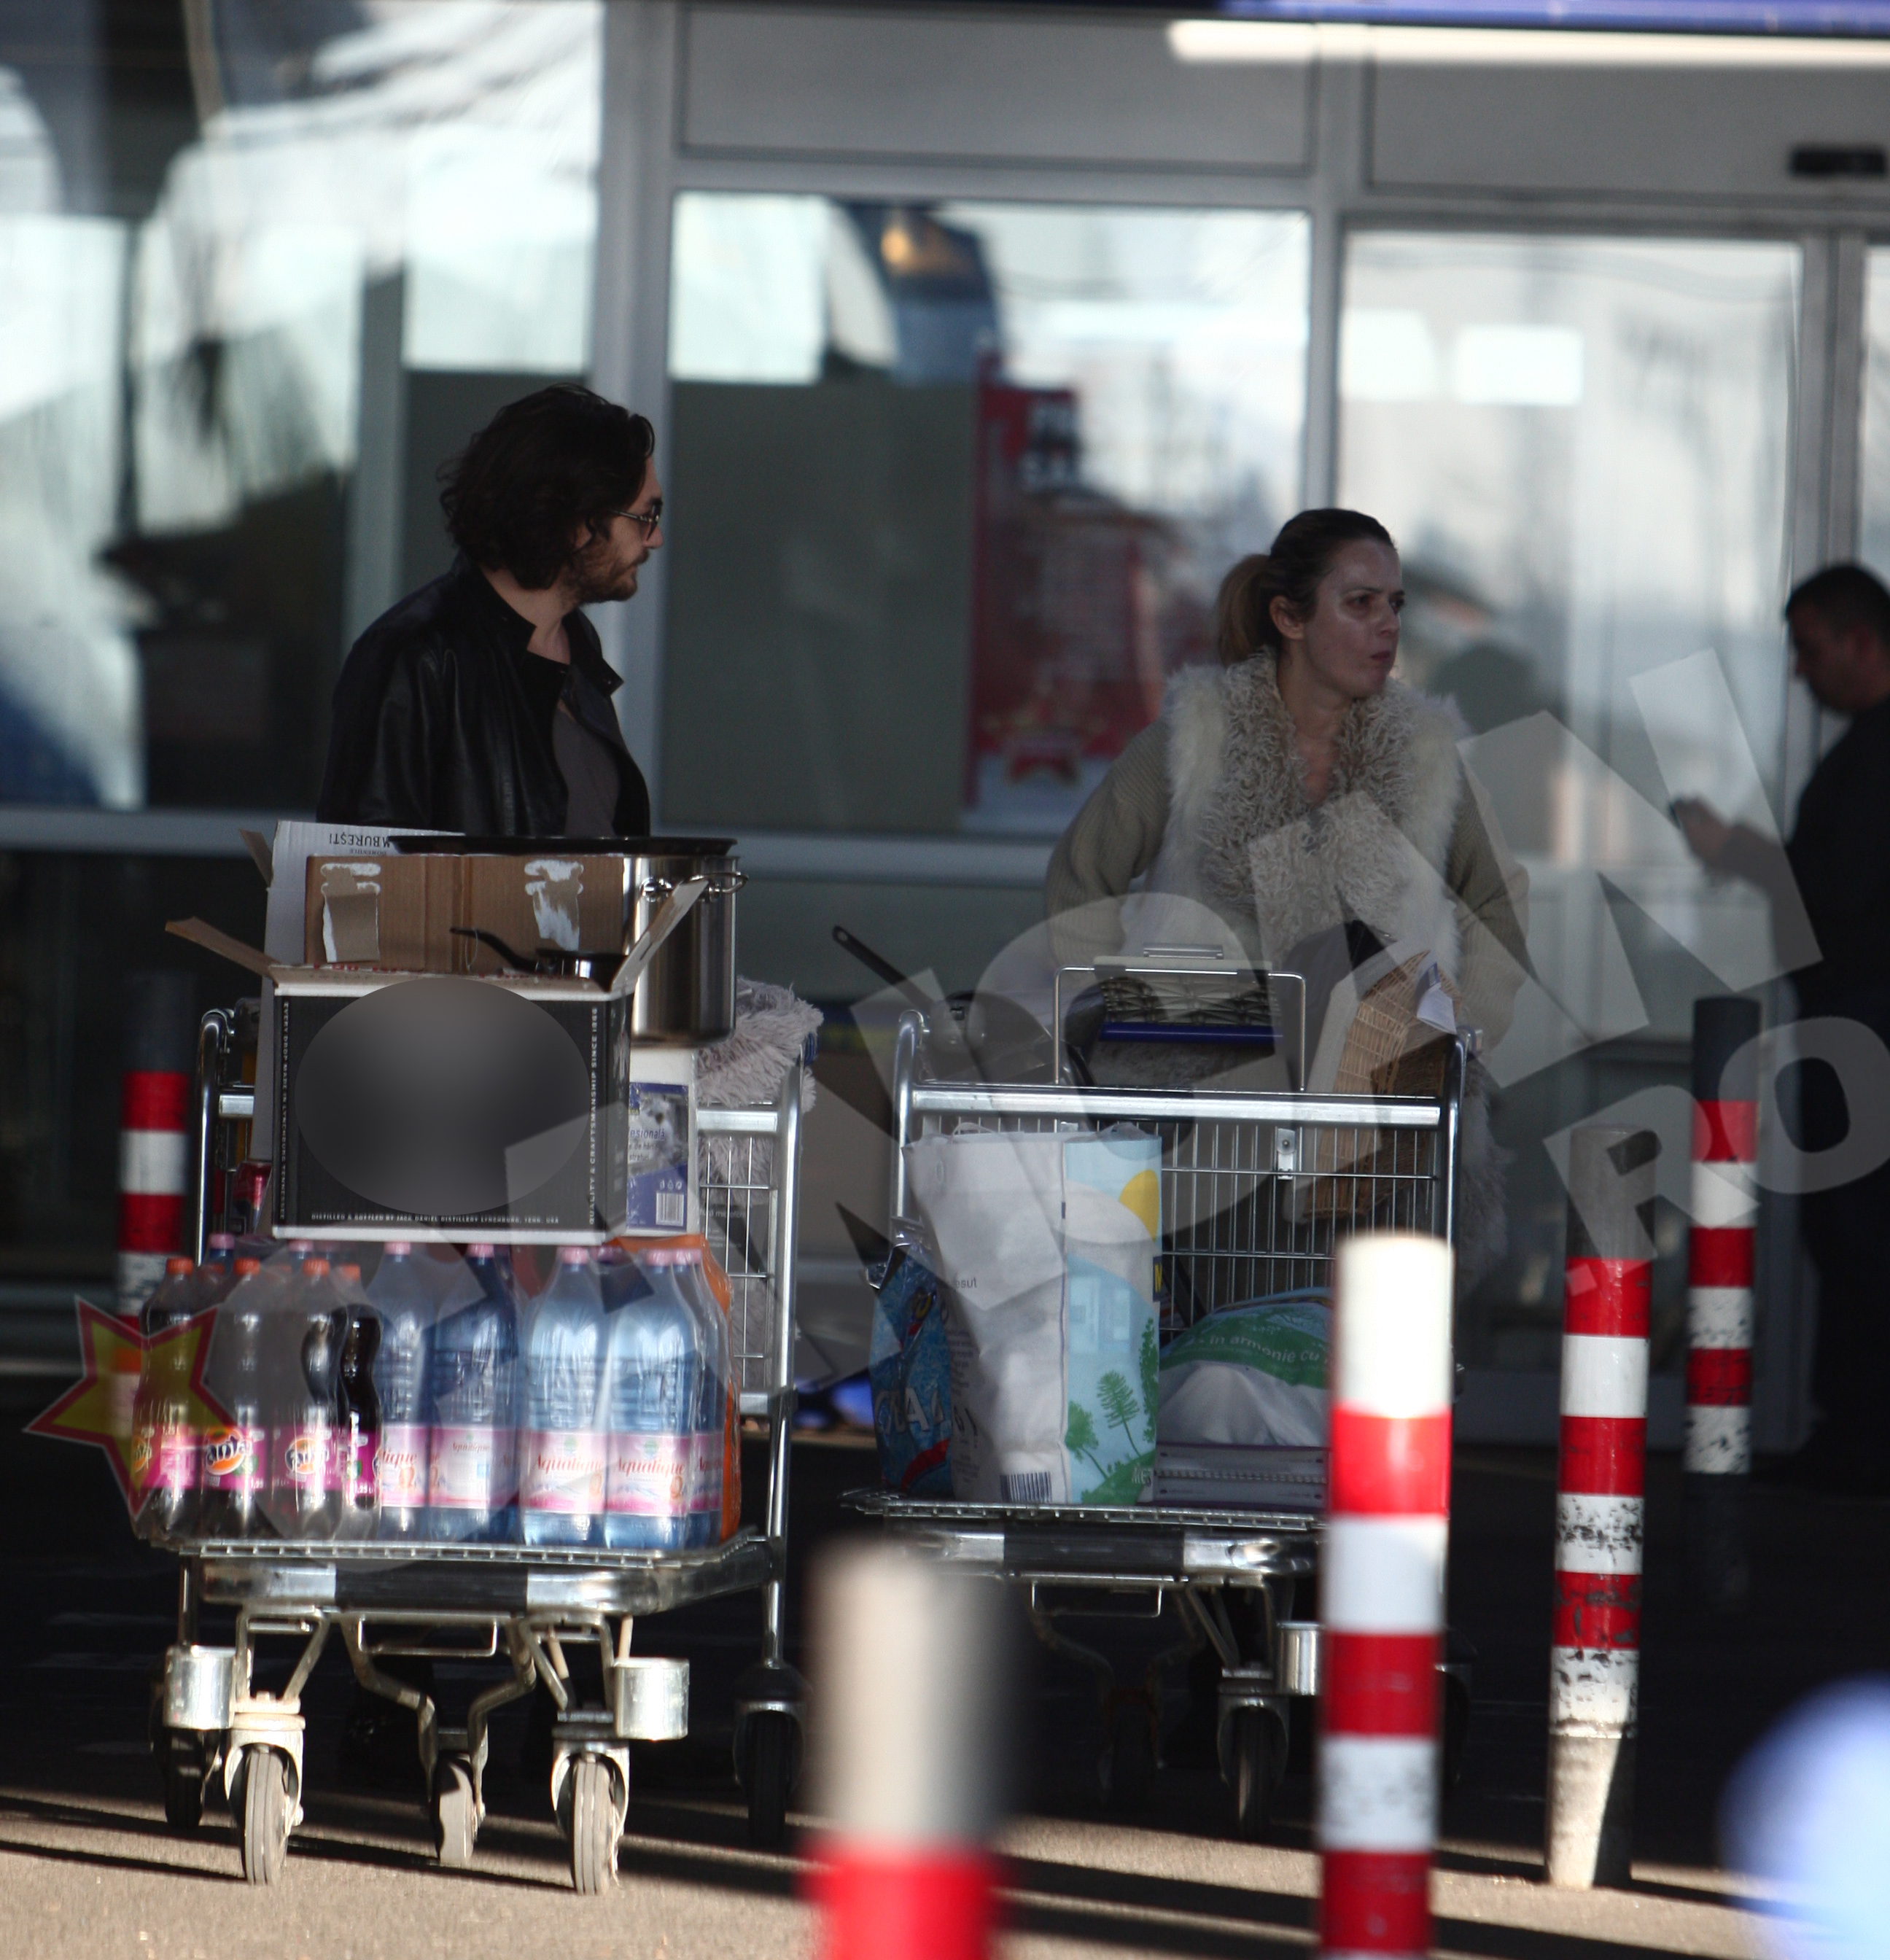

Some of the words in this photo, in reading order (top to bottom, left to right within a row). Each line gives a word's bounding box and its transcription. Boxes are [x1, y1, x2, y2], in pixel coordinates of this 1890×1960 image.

[282, 1092, 287, 1102] IN
[589, 1166, 596, 1175] &
[354, 1213, 384, 1221] BOTTLED
[1229, 1335, 1296, 1363] armonie
[1300, 1350, 1320, 1361] cu
[617, 1456, 685, 1477] Aquatique
